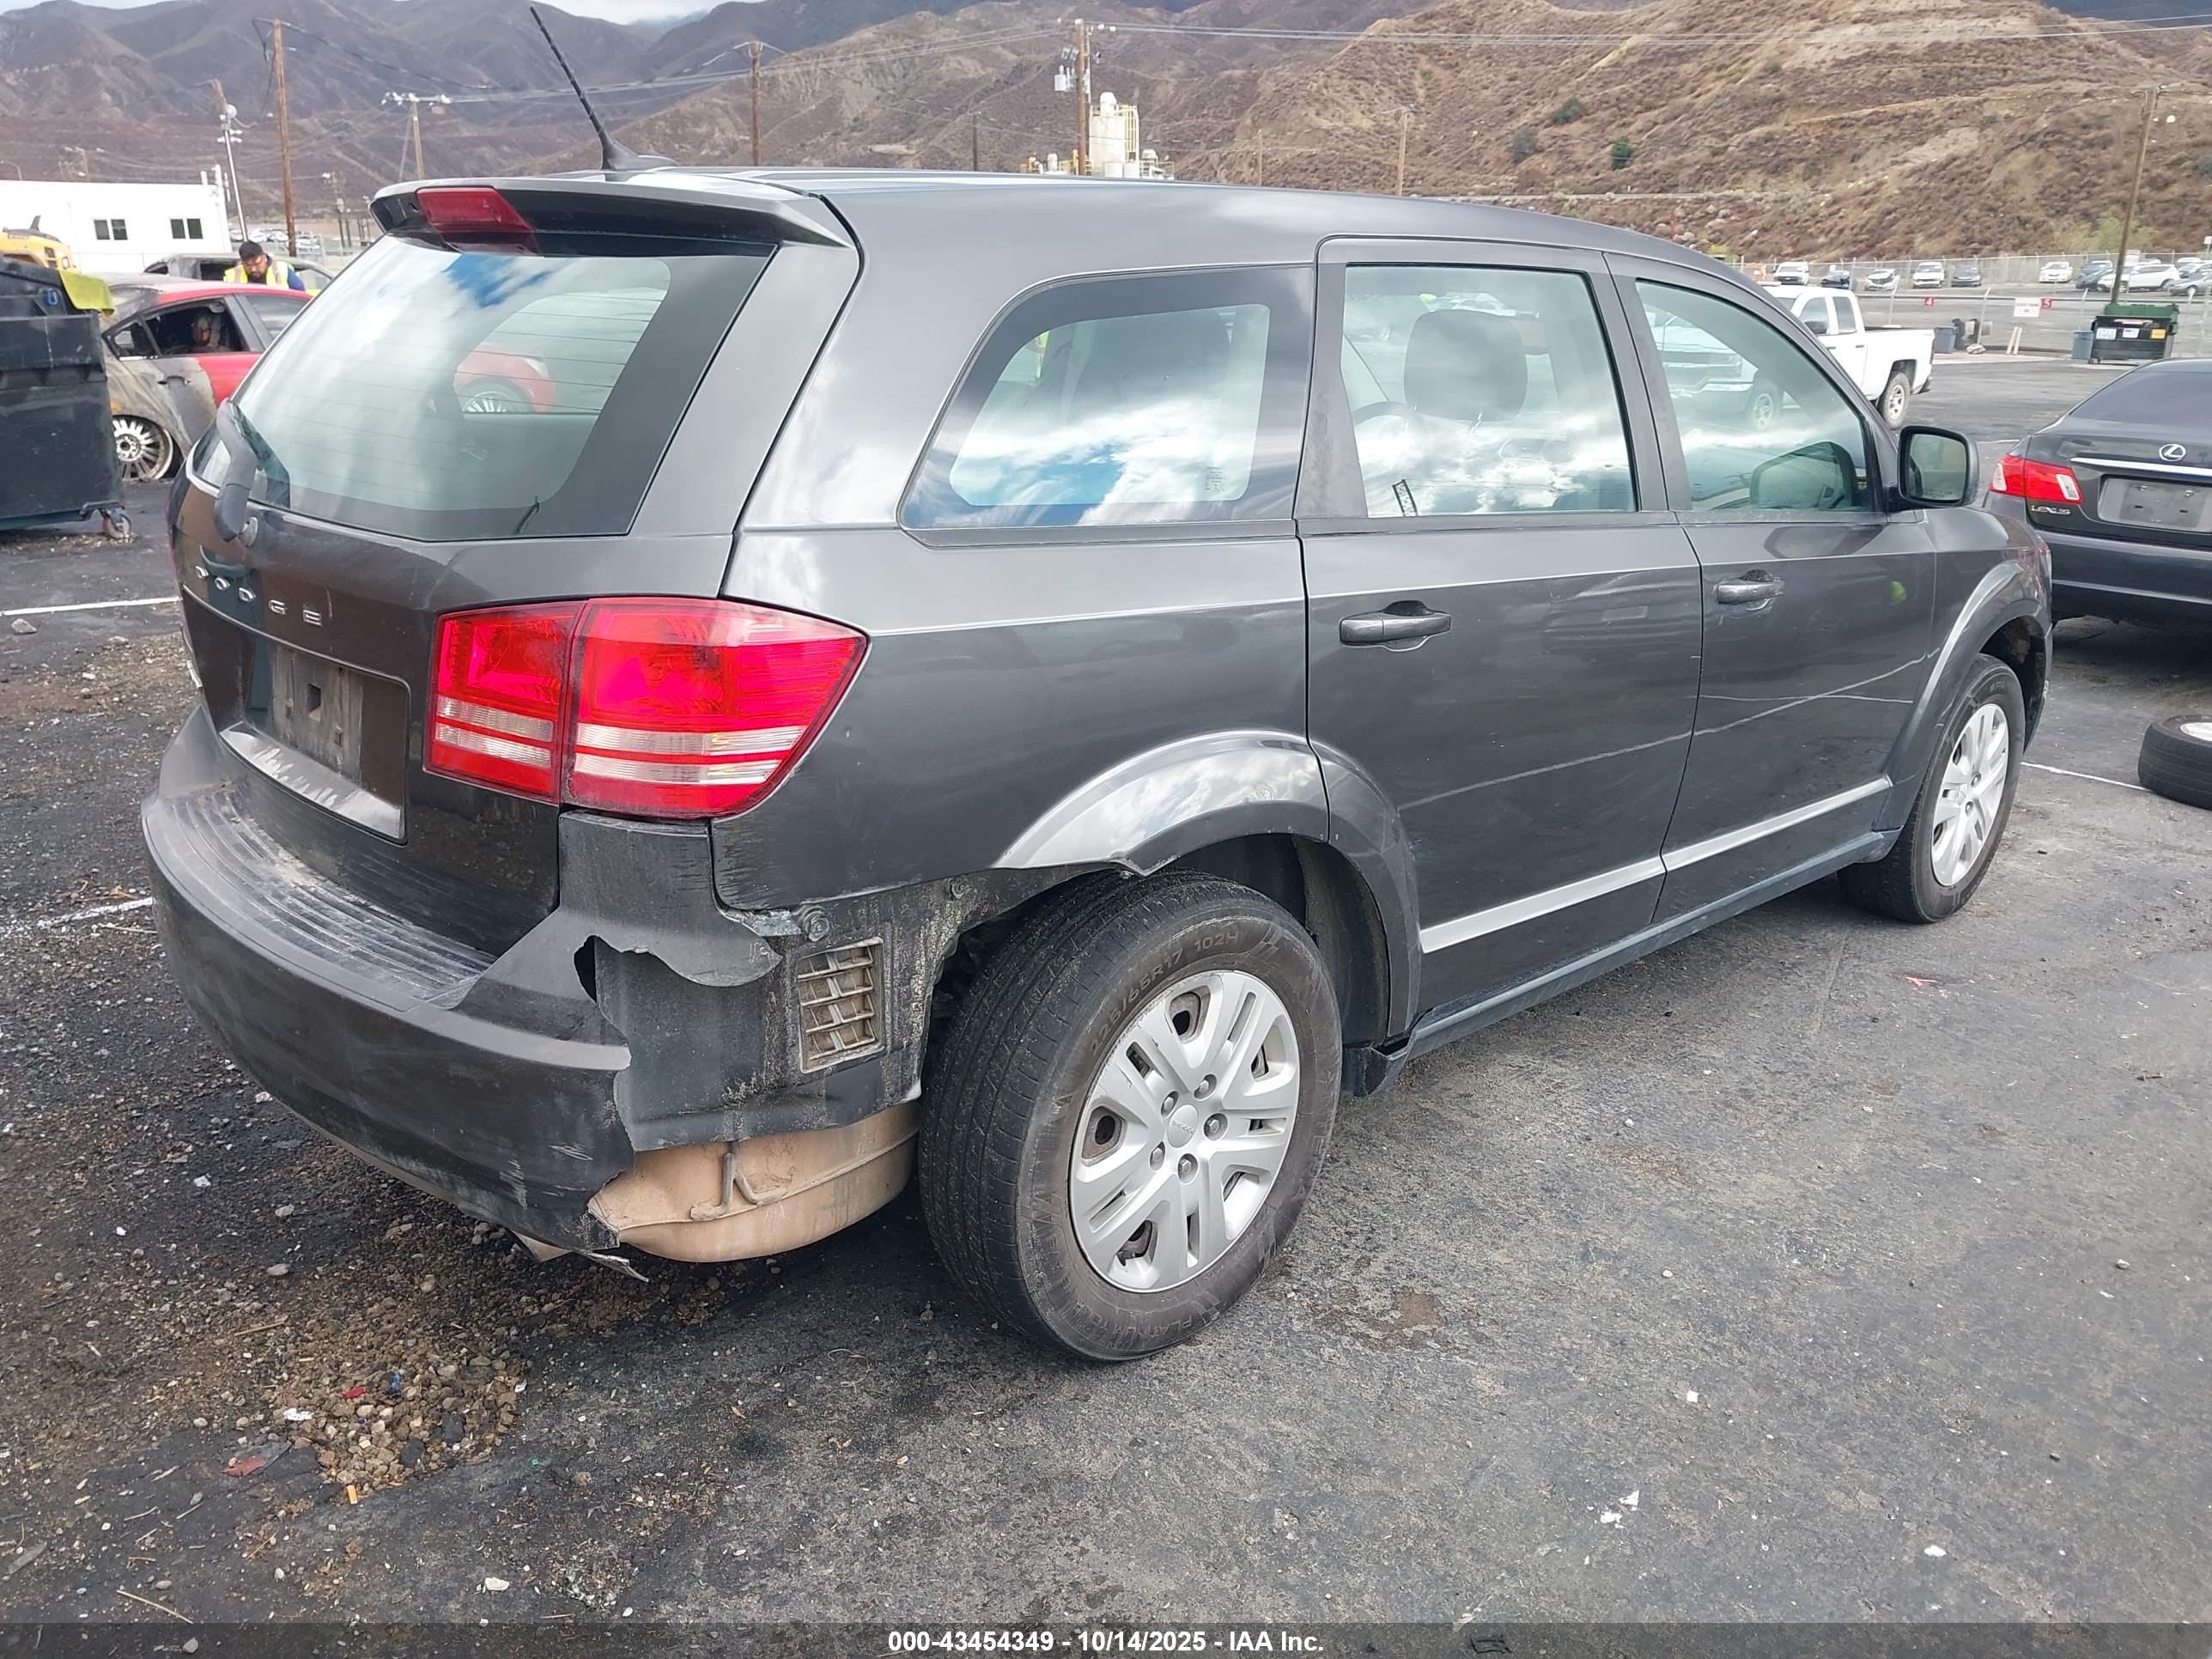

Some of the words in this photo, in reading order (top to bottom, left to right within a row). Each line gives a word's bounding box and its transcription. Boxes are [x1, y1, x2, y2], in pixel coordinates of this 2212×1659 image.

[2031, 505, 2071, 515] LEXUS
[196, 566, 323, 627] DODGE
[1194, 931, 1238, 951] 102H
